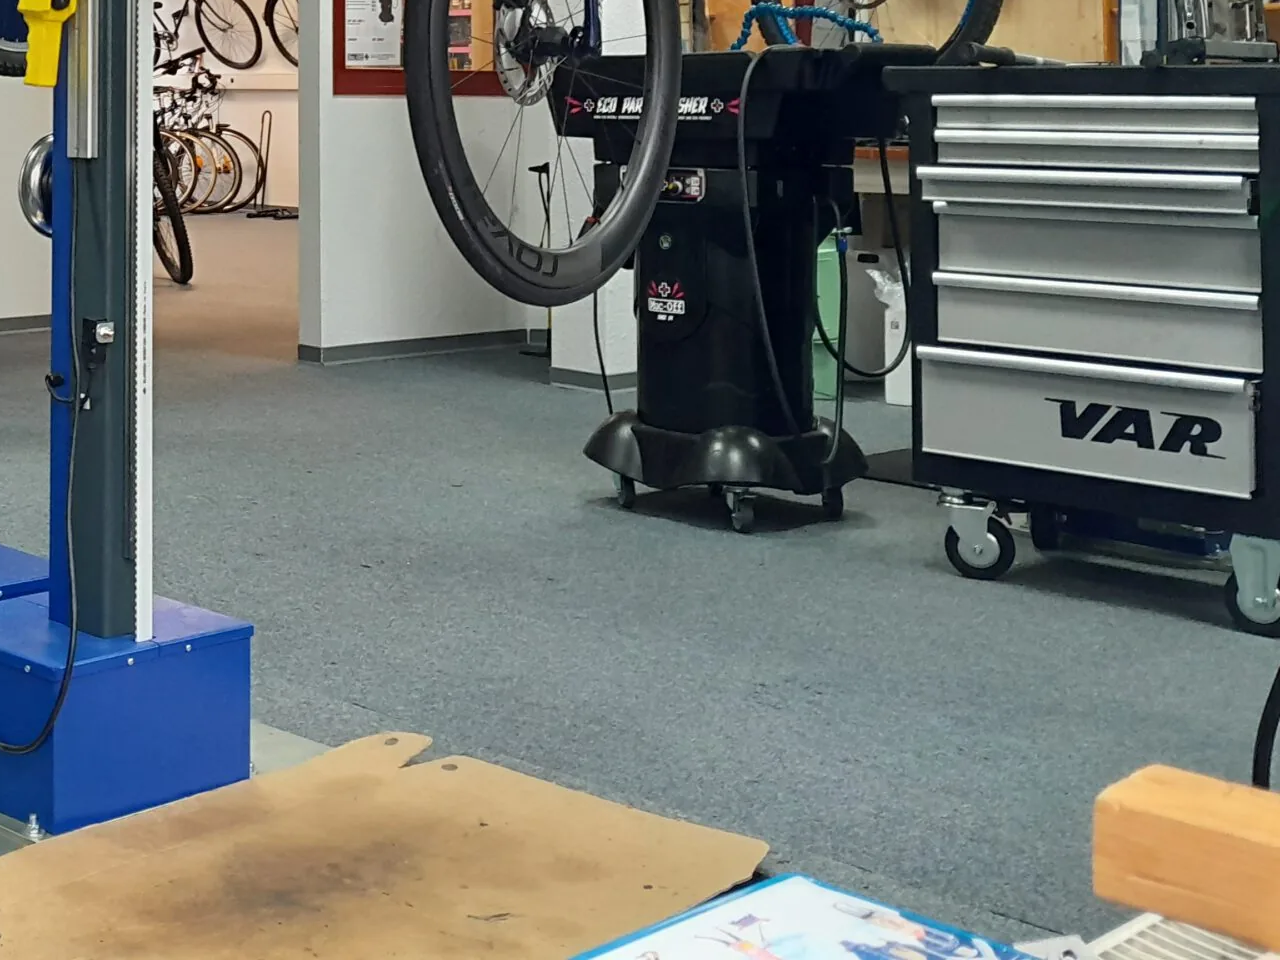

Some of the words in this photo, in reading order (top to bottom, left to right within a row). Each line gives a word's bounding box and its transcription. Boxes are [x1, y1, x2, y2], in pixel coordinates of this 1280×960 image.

[596, 96, 619, 114] ECO
[621, 96, 644, 114] PAR
[678, 96, 709, 115] SHER
[1044, 398, 1226, 459] VAR
